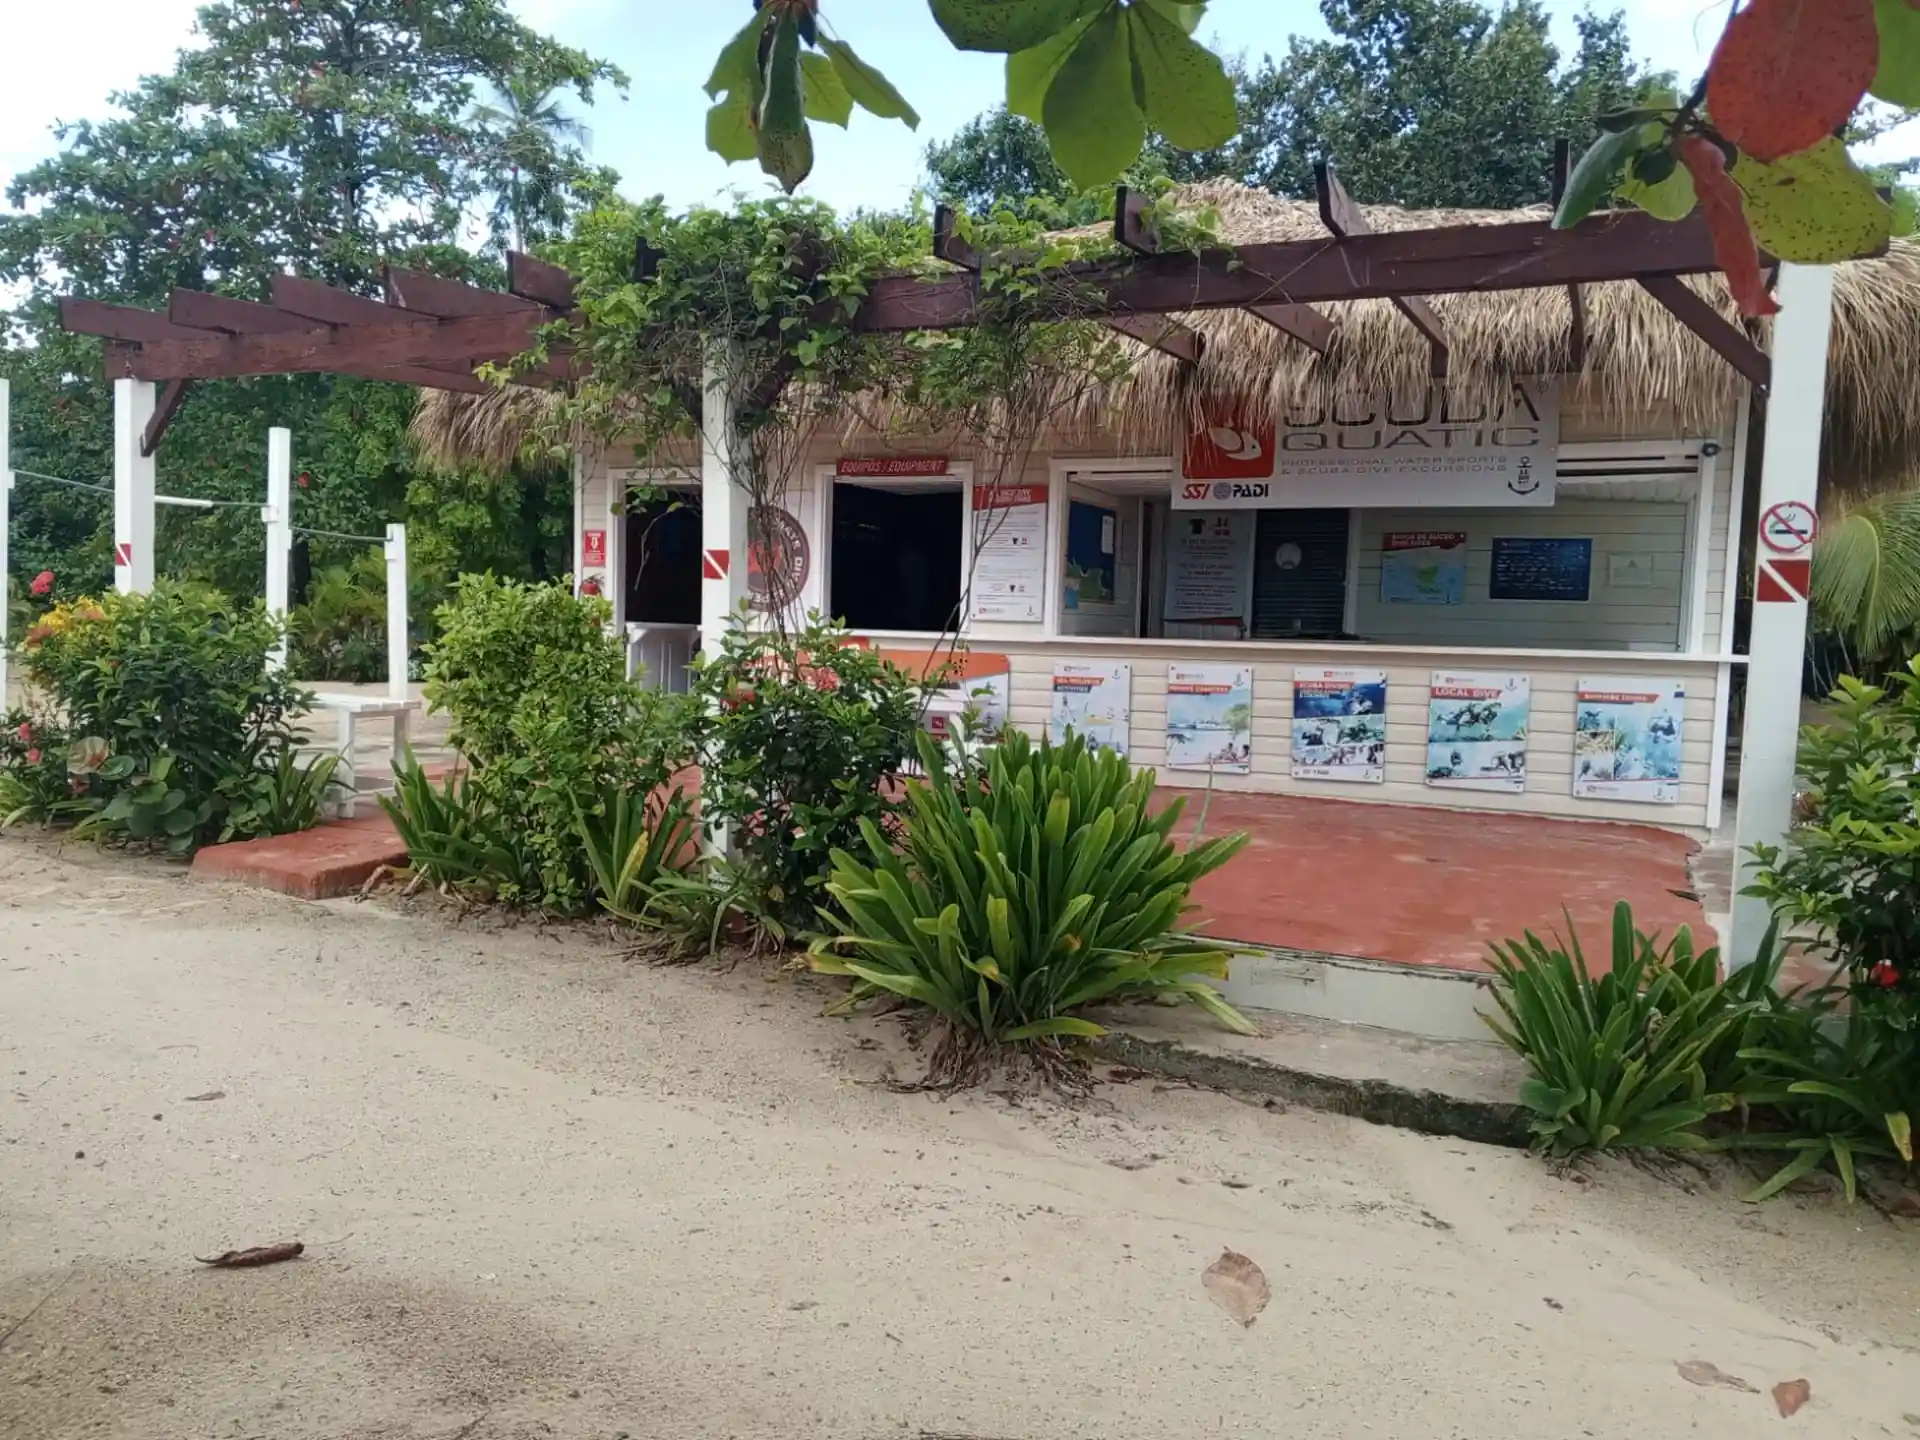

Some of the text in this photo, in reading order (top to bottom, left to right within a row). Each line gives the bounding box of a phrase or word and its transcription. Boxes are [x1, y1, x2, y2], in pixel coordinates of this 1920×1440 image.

[1282, 427, 1541, 451] QUATIC
[888, 460, 945, 473] EQUIPMENT
[1281, 455, 1507, 467] PROFESSIONAL WATER SPORTS
[1297, 466, 1350, 475] SCUBA
[1356, 465, 1392, 474] DIVE
[1399, 464, 1507, 473] EXCURSIONS
[1182, 483, 1211, 500] SSI
[1232, 483, 1269, 498] PADI
[1435, 686, 1470, 697] LOCAL
